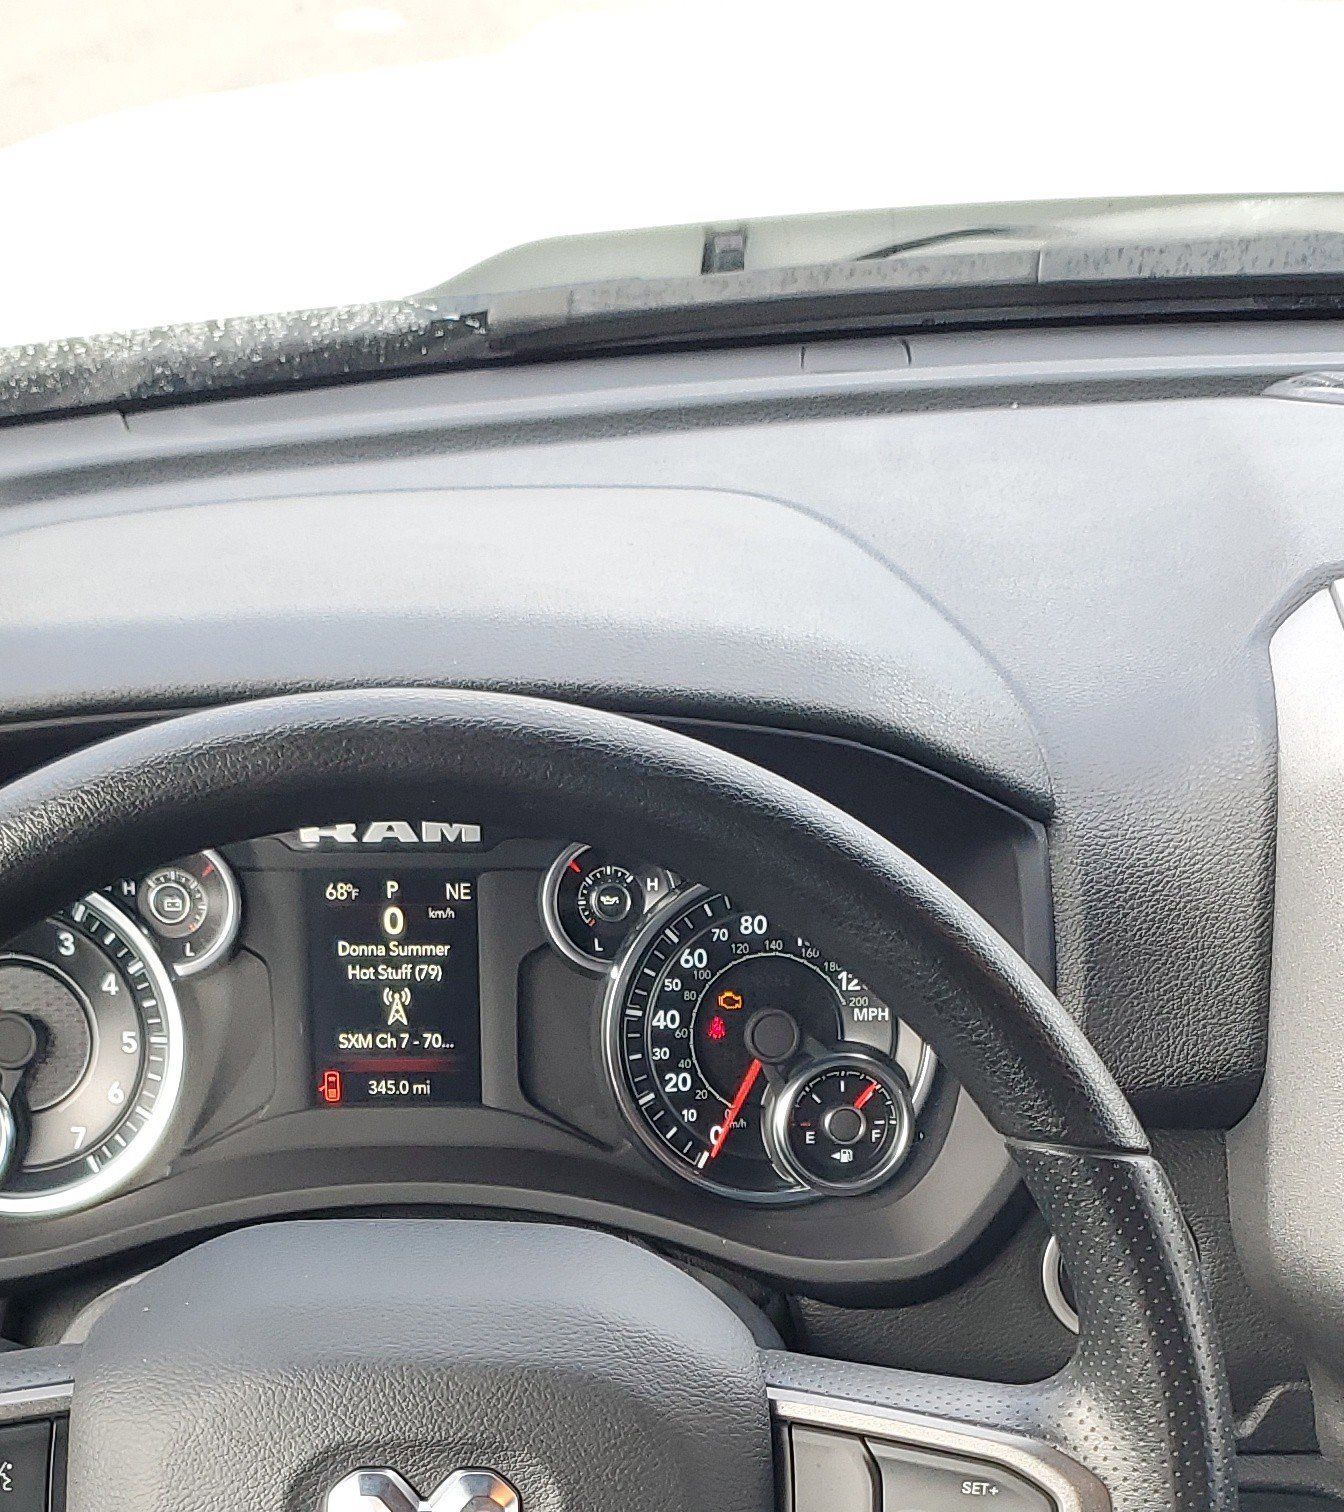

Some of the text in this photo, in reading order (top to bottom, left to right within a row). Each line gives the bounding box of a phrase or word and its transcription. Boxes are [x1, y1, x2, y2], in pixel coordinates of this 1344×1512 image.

[299, 821, 481, 843] RAM
[122, 880, 137, 896] H
[386, 880, 400, 899] P
[445, 882, 472, 900] NE
[646, 877, 659, 891] H
[325, 883, 360, 901] 68°F
[382, 906, 405, 935] 0
[428, 907, 456, 920] km/h
[739, 915, 768, 936] 80
[711, 928, 729, 942] 70
[58, 932, 75, 956] 3
[184, 942, 195, 957] L
[337, 941, 450, 957] Donna Summer
[594, 937, 604, 952] L
[730, 943, 750, 955] 120
[764, 939, 784, 951] 140
[680, 949, 708, 970] 60
[347, 964, 443, 982] Hot Stuff (79)
[692, 969, 712, 981] 100
[837, 970, 868, 991] 12
[100, 973, 119, 996] 4
[663, 978, 682, 992] 50
[683, 990, 697, 1002] 80
[849, 996, 869, 1007] 200
[651, 1009, 680, 1030] 40
[853, 1007, 890, 1022] MPH
[674, 1027, 688, 1039] 60
[121, 1031, 139, 1055] 5
[338, 1033, 373, 1049] SXM
[375, 1033, 397, 1049] Ch
[399, 1034, 408, 1049] 7
[651, 1047, 670, 1061] 30
[678, 1059, 692, 1069] 40
[367, 1080, 431, 1095] 345.0 mi
[663, 1072, 692, 1093] 20
[107, 1082, 125, 1105] 6
[695, 1089, 708, 1100] 20
[681, 1108, 697, 1122] 10
[730, 1117, 747, 1129] m/h
[69, 1127, 87, 1150] 7
[805, 1131, 816, 1144] E
[871, 1129, 882, 1142] F
[961, 1480, 999, 1497] SET+
